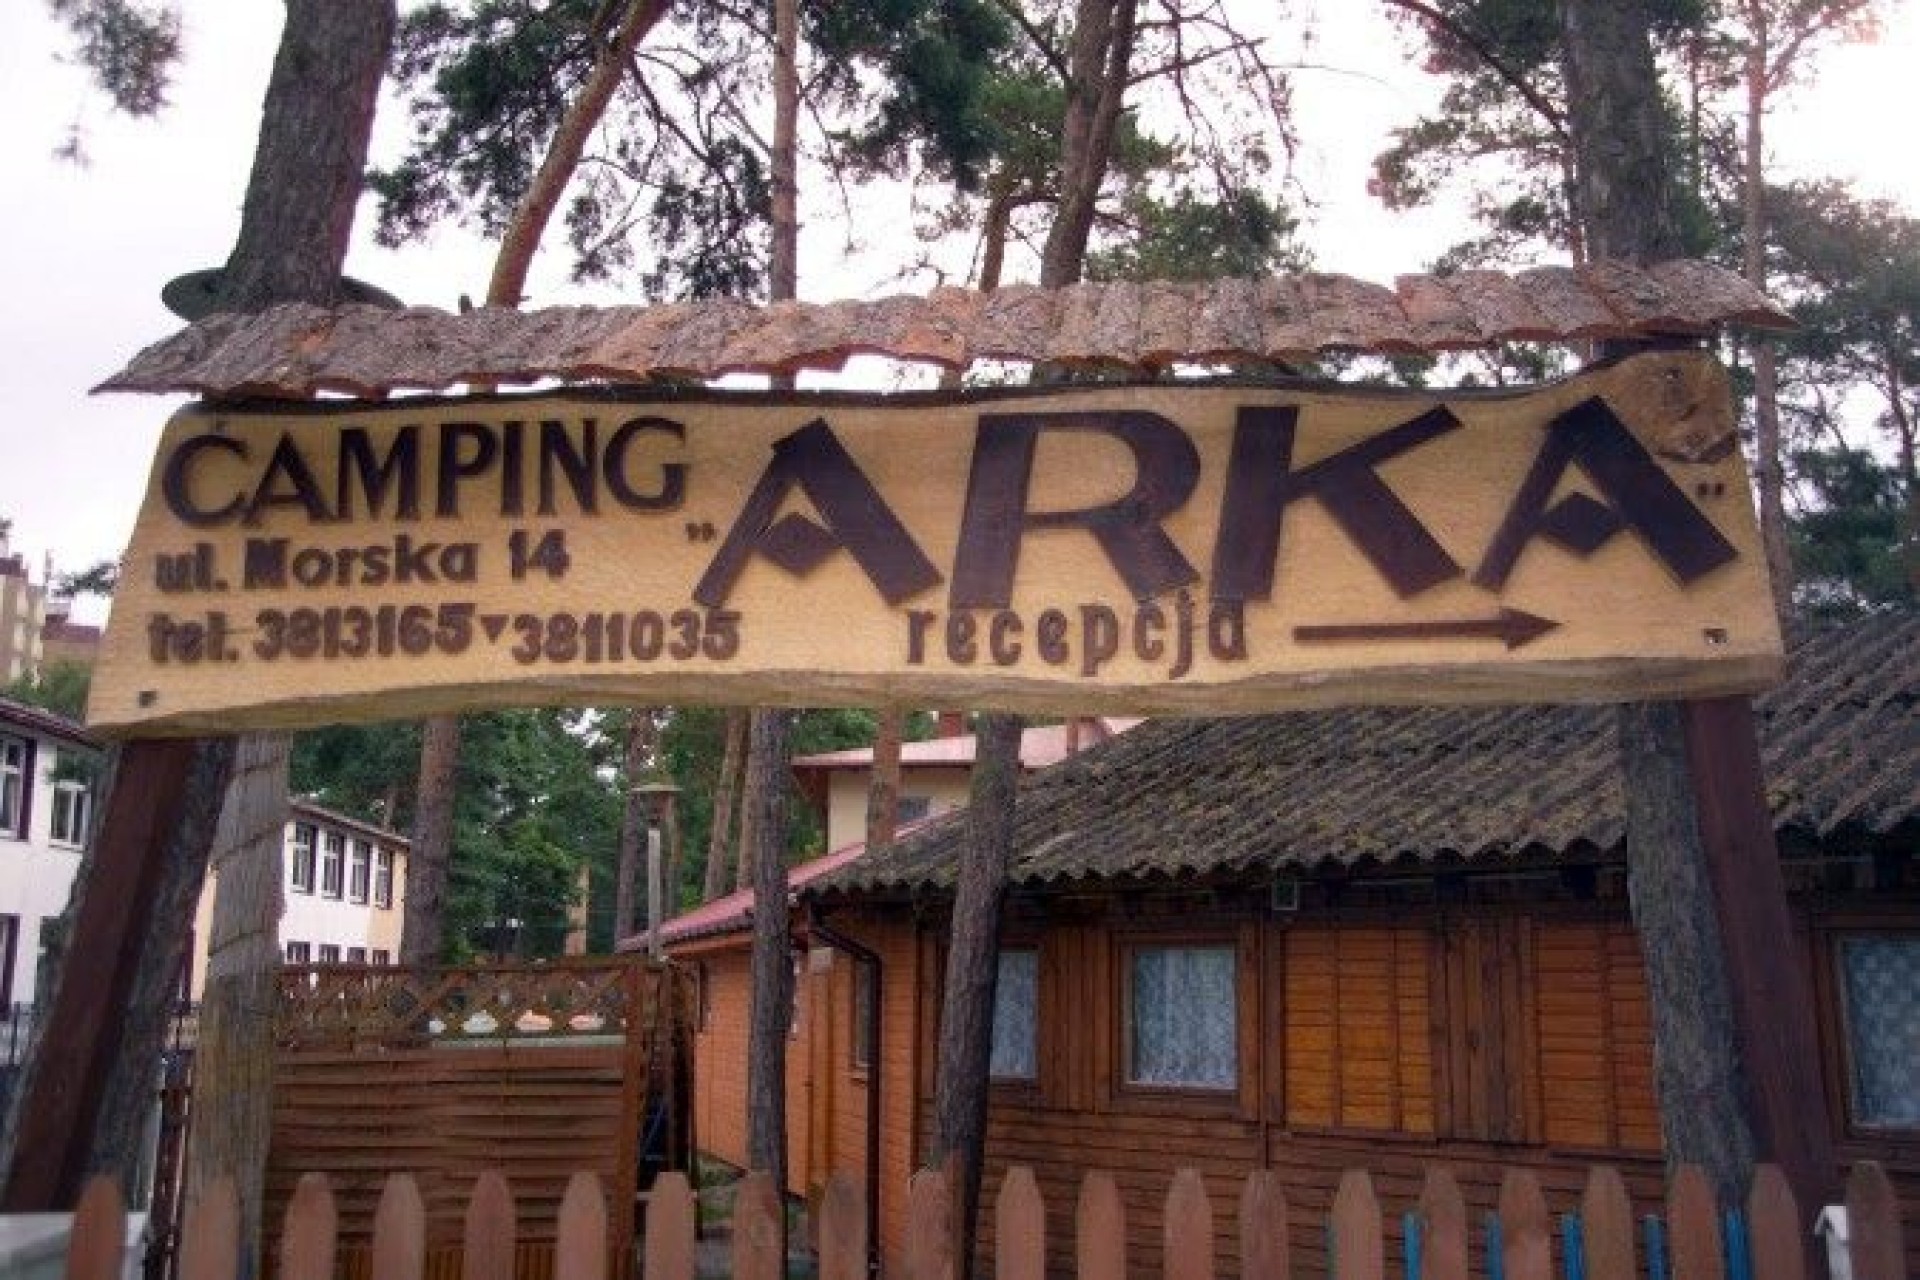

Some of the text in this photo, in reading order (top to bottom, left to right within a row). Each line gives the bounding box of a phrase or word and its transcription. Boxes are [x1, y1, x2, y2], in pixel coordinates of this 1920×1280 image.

[162, 416, 692, 526] CAMPING
[155, 529, 569, 593] ul. Morska 14
[149, 603, 741, 666] tel. 3813165 3811035
[907, 588, 1247, 680] recepcja
